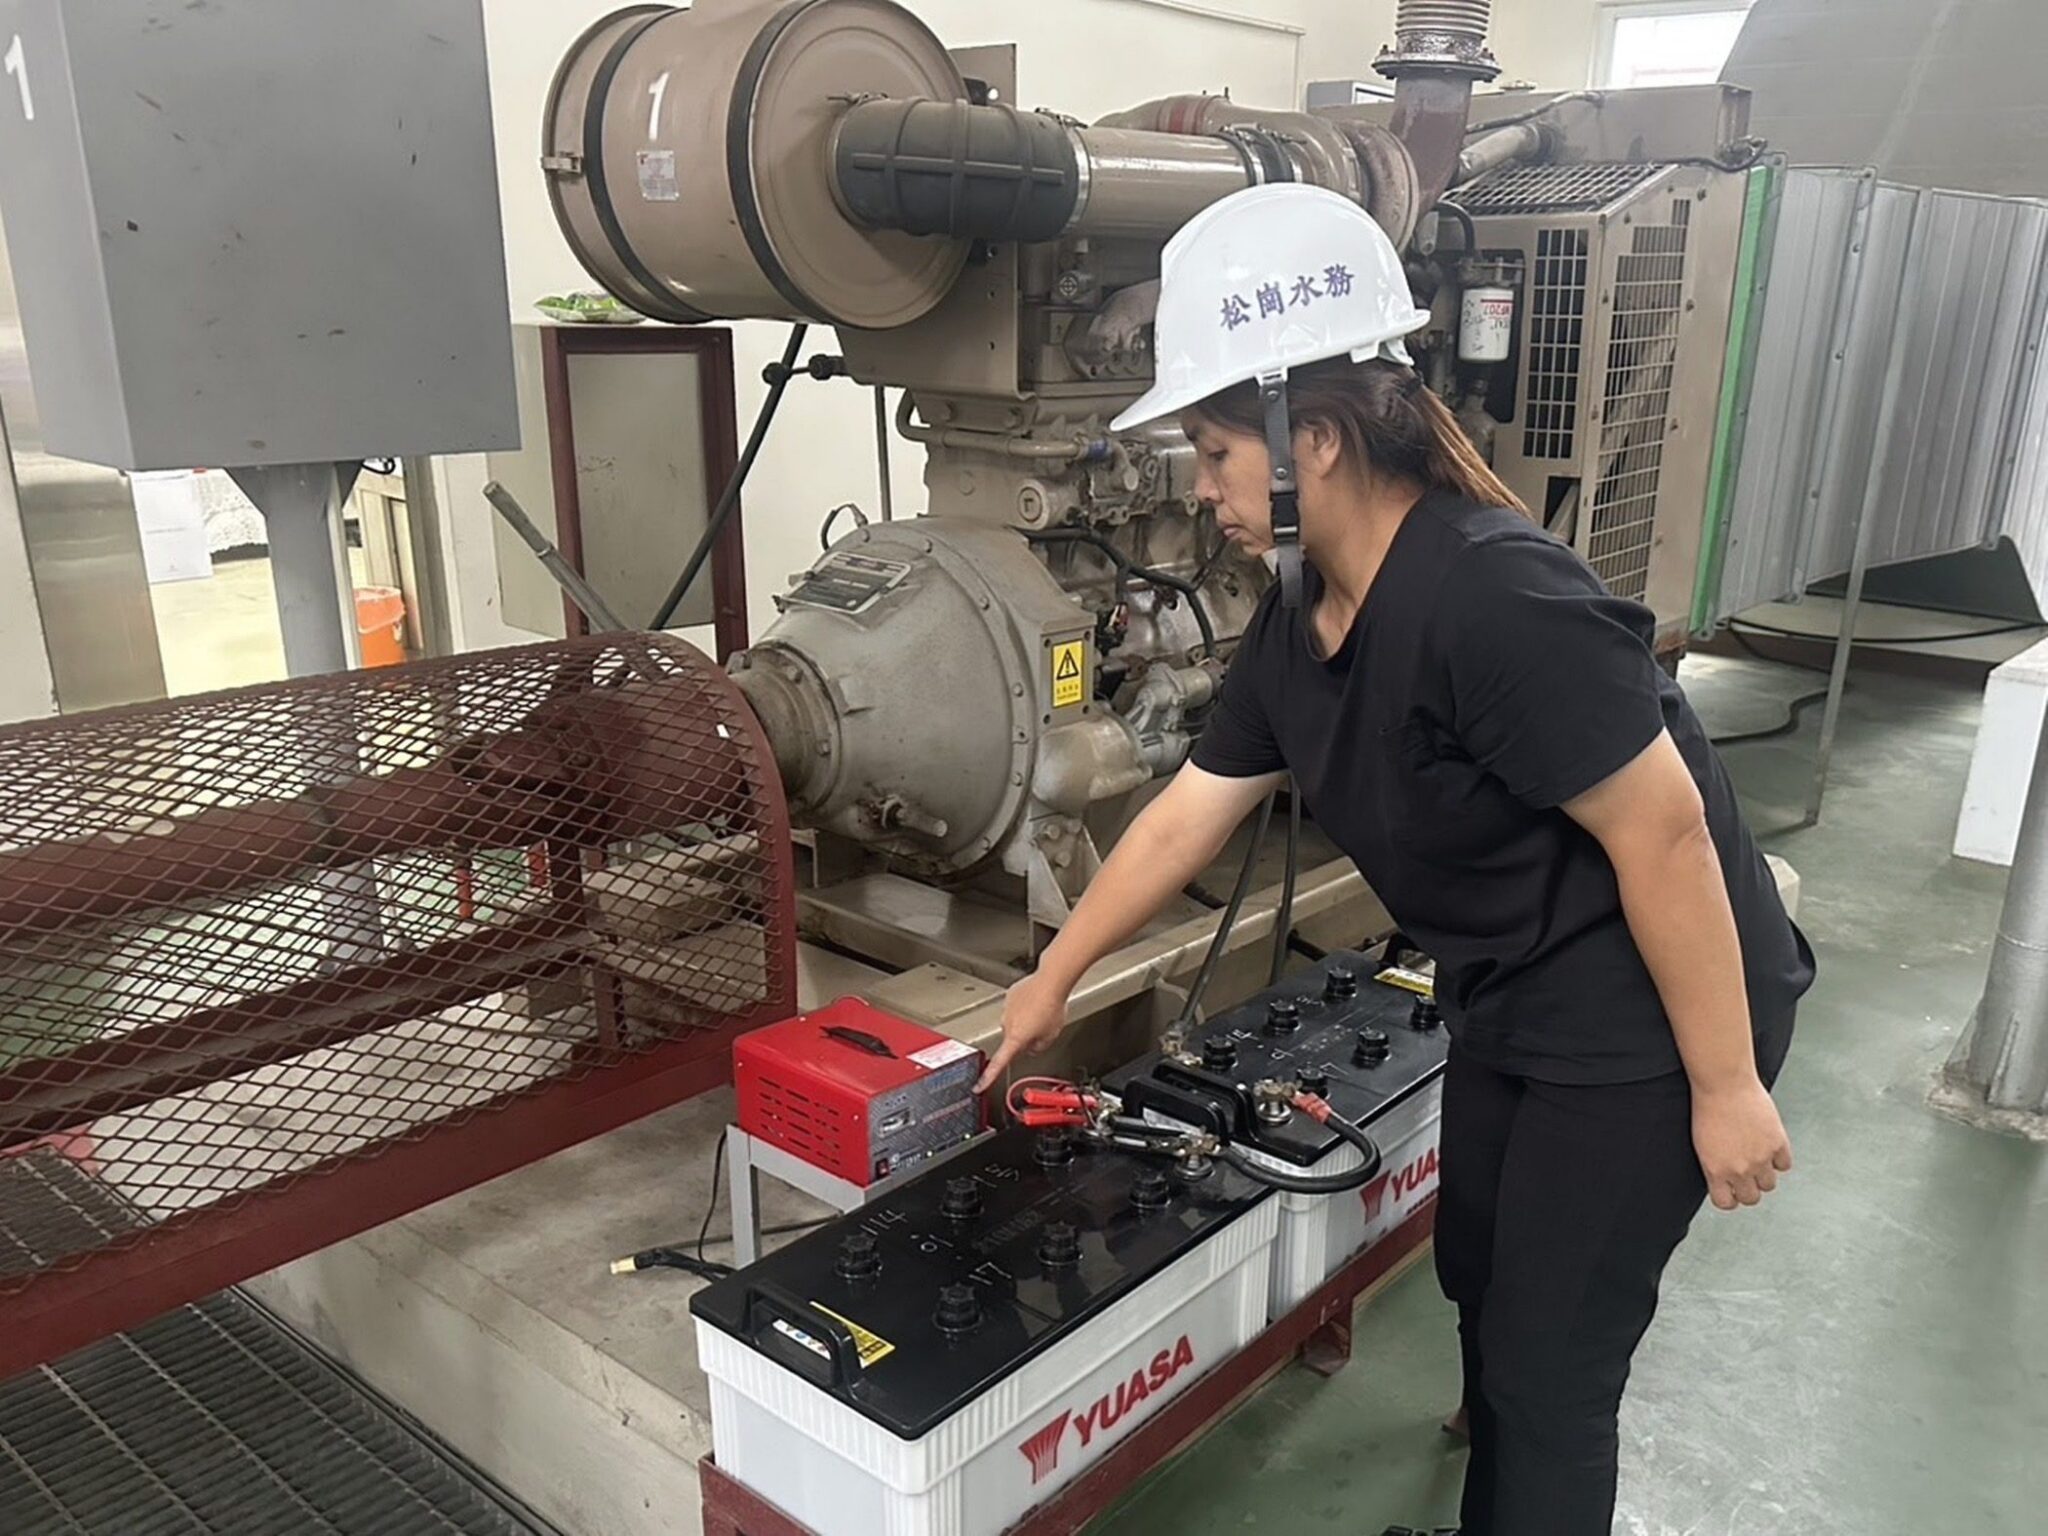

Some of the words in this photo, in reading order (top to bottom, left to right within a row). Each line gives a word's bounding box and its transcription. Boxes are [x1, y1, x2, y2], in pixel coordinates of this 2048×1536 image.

[4, 34, 34, 120] 1
[648, 72, 669, 140] 1
[1390, 1147, 1440, 1203] YUA
[1073, 1334, 1193, 1447] YUASA
